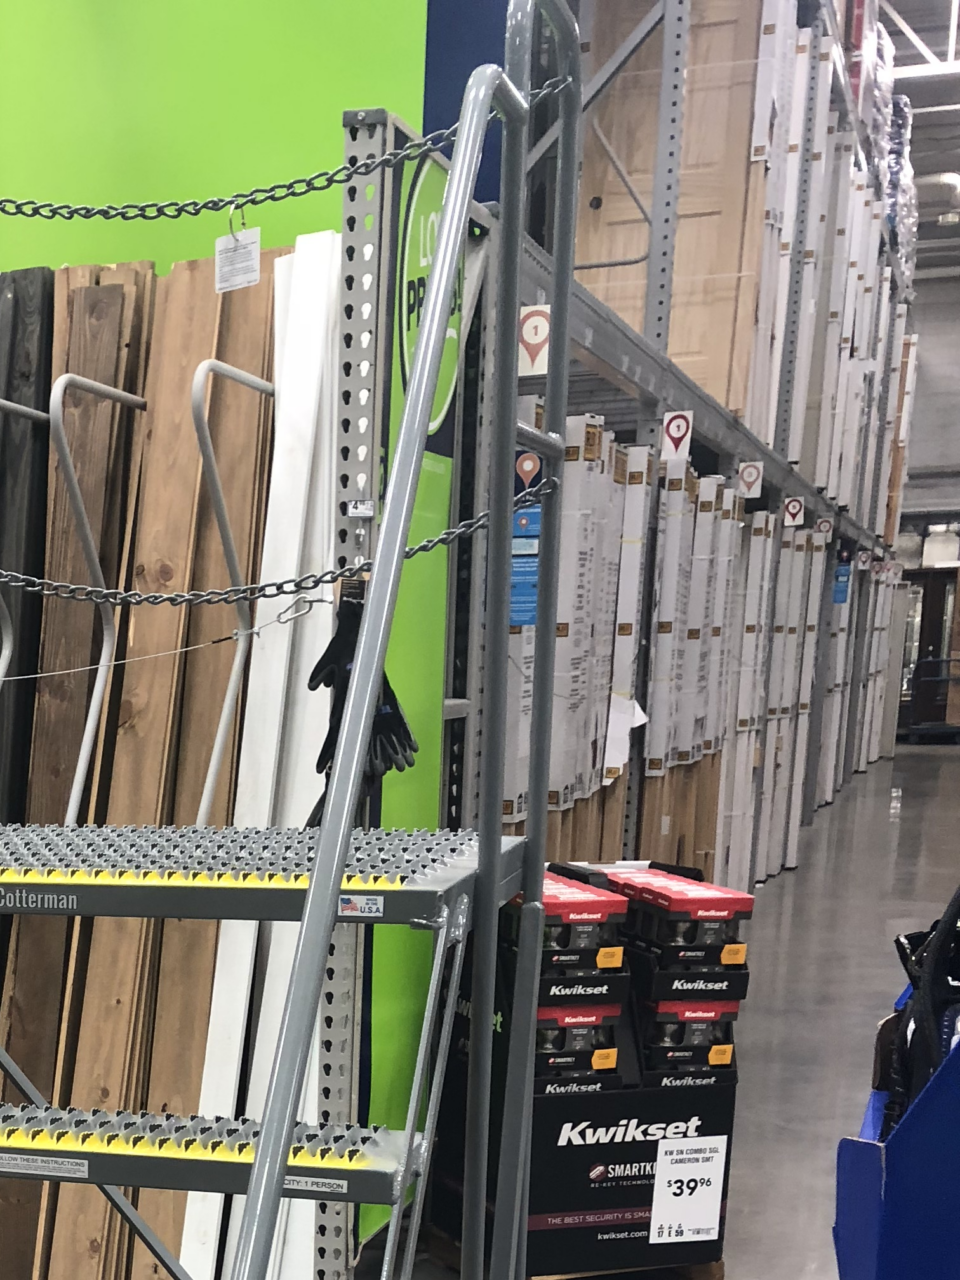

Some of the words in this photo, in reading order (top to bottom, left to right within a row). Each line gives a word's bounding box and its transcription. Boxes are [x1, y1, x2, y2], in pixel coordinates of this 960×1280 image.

[533, 325, 538, 336] 1
[672, 979, 729, 990] Kwikset
[549, 985, 609, 996] Kwikset
[661, 1077, 717, 1087] Kwikset
[545, 1083, 602, 1094] Kwikset
[557, 1116, 702, 1146] Kwikset
[40, 1159, 85, 1168] INSTRUCTIONS
[564, 1216, 584, 1224] BEST
[585, 1213, 622, 1222] SECURITY
[597, 1231, 648, 1240] kwikset.com
